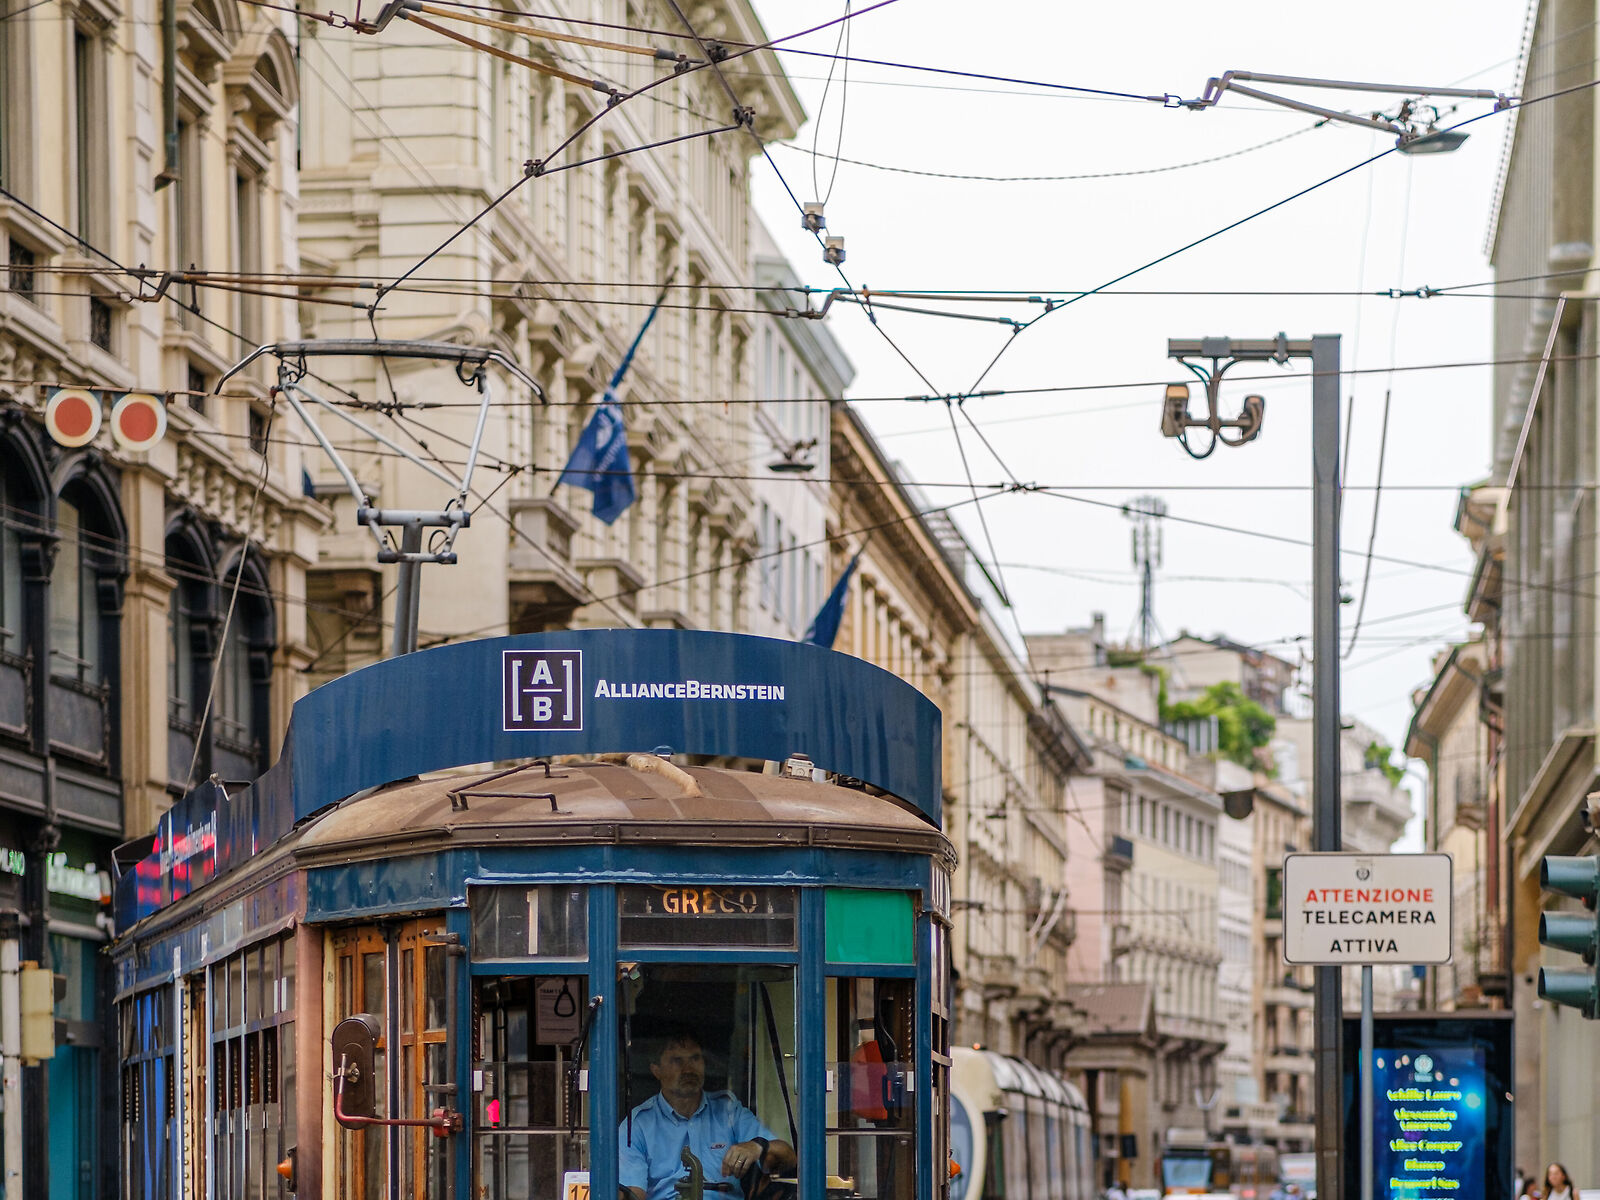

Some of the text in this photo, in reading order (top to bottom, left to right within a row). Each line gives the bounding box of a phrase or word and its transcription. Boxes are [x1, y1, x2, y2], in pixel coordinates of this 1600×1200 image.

[1305, 888, 1434, 903] ATTENZIONE
[527, 888, 757, 955] 1 GRECO
[1302, 910, 1436, 924] TELECAMERA
[1330, 939, 1398, 953] ATTIVA
